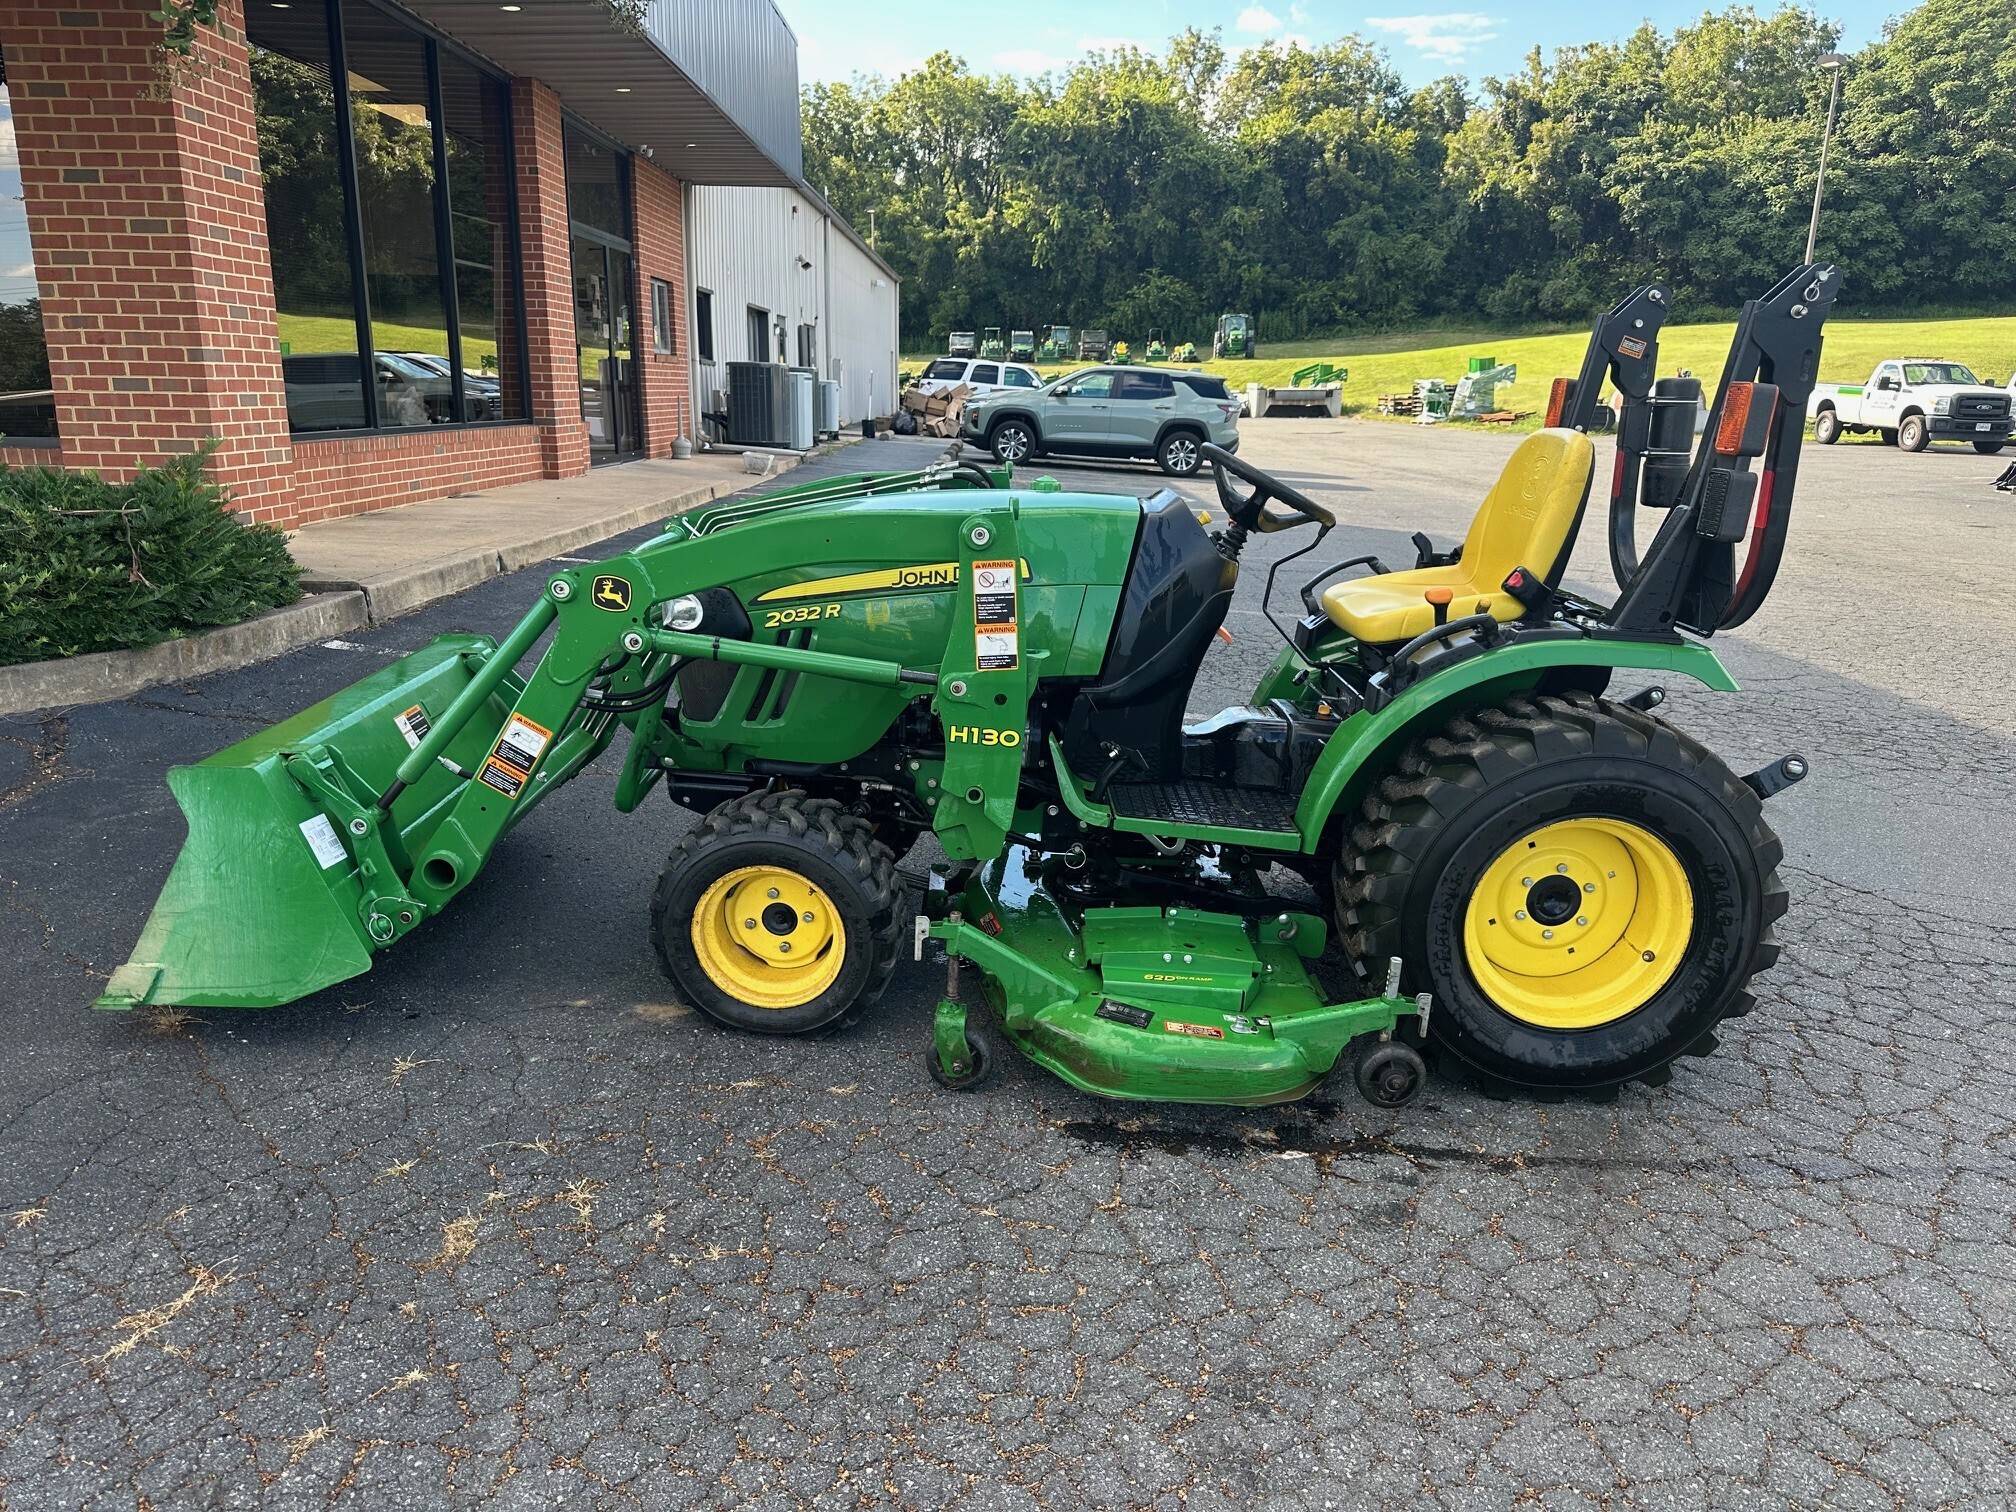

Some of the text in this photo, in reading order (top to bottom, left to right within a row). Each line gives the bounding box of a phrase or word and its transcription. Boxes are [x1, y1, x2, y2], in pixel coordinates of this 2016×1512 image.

[892, 570, 948, 586] JOHN
[764, 603, 841, 628] 2032 R
[523, 720, 548, 737] WARNING
[949, 725, 1021, 748] H130
[498, 763, 523, 780] WARNING
[1143, 973, 1177, 983] 62D
